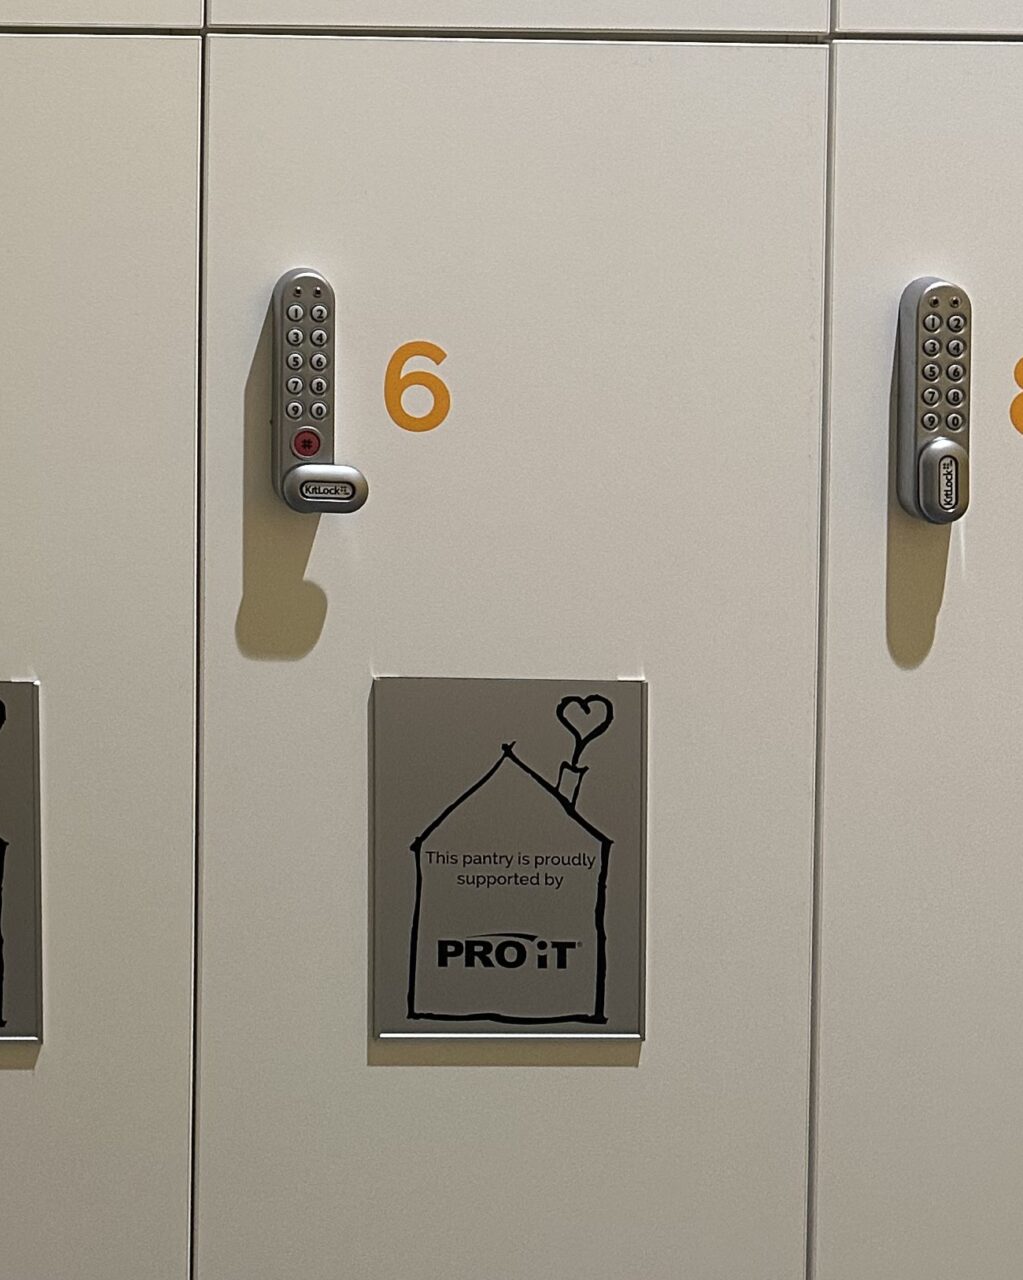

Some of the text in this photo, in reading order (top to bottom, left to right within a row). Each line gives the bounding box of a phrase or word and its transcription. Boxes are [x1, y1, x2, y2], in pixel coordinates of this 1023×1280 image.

[294, 309, 323, 319] 1 2
[931, 318, 961, 329] 1 2
[292, 332, 324, 343] 3 4
[929, 342, 960, 353] 3 4
[292, 357, 323, 368] 5 6
[928, 366, 960, 378] 5 6
[292, 381, 323, 392] 7 8
[385, 342, 450, 432] 6
[928, 391, 960, 402] 7 8
[291, 405, 323, 417] 9 0
[928, 416, 959, 427] 9 0
[426, 851, 596, 870] This pantry is proudly
[457, 873, 564, 889] supported by
